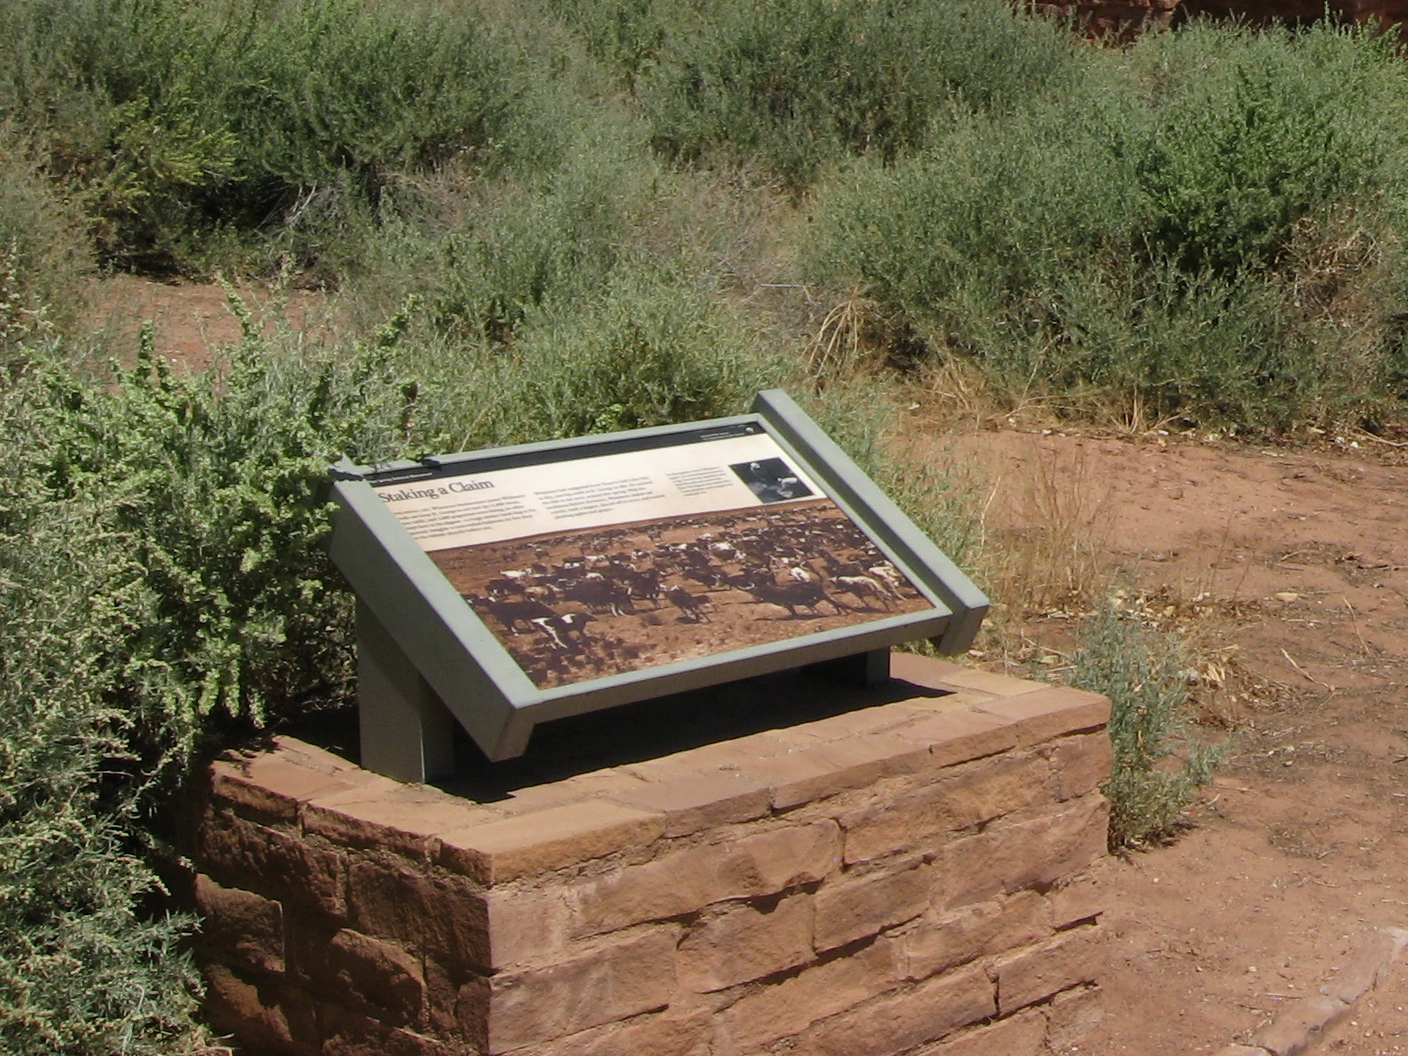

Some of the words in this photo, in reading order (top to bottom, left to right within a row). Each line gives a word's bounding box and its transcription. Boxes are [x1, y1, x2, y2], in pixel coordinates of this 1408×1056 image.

[378, 489, 439, 503] Staking
[439, 487, 449, 495] a
[449, 480, 495, 493] Claim
